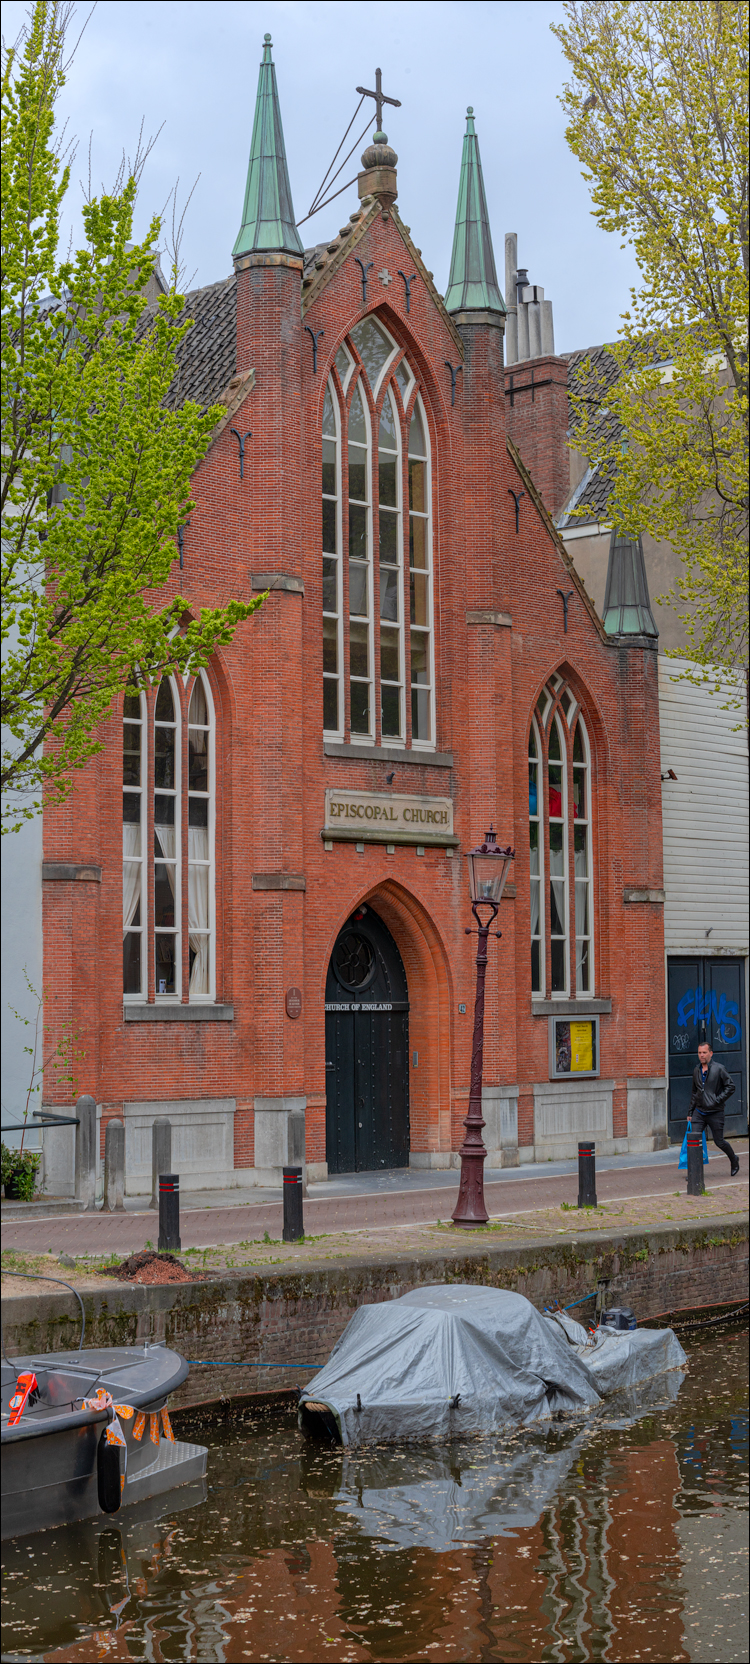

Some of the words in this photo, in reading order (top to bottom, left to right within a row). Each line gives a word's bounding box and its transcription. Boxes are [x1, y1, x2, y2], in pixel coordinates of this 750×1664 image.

[330, 803, 398, 820] EPISCOPAL
[351, 1003, 360, 1011] OF
[361, 1003, 393, 1011] ENGLAND
